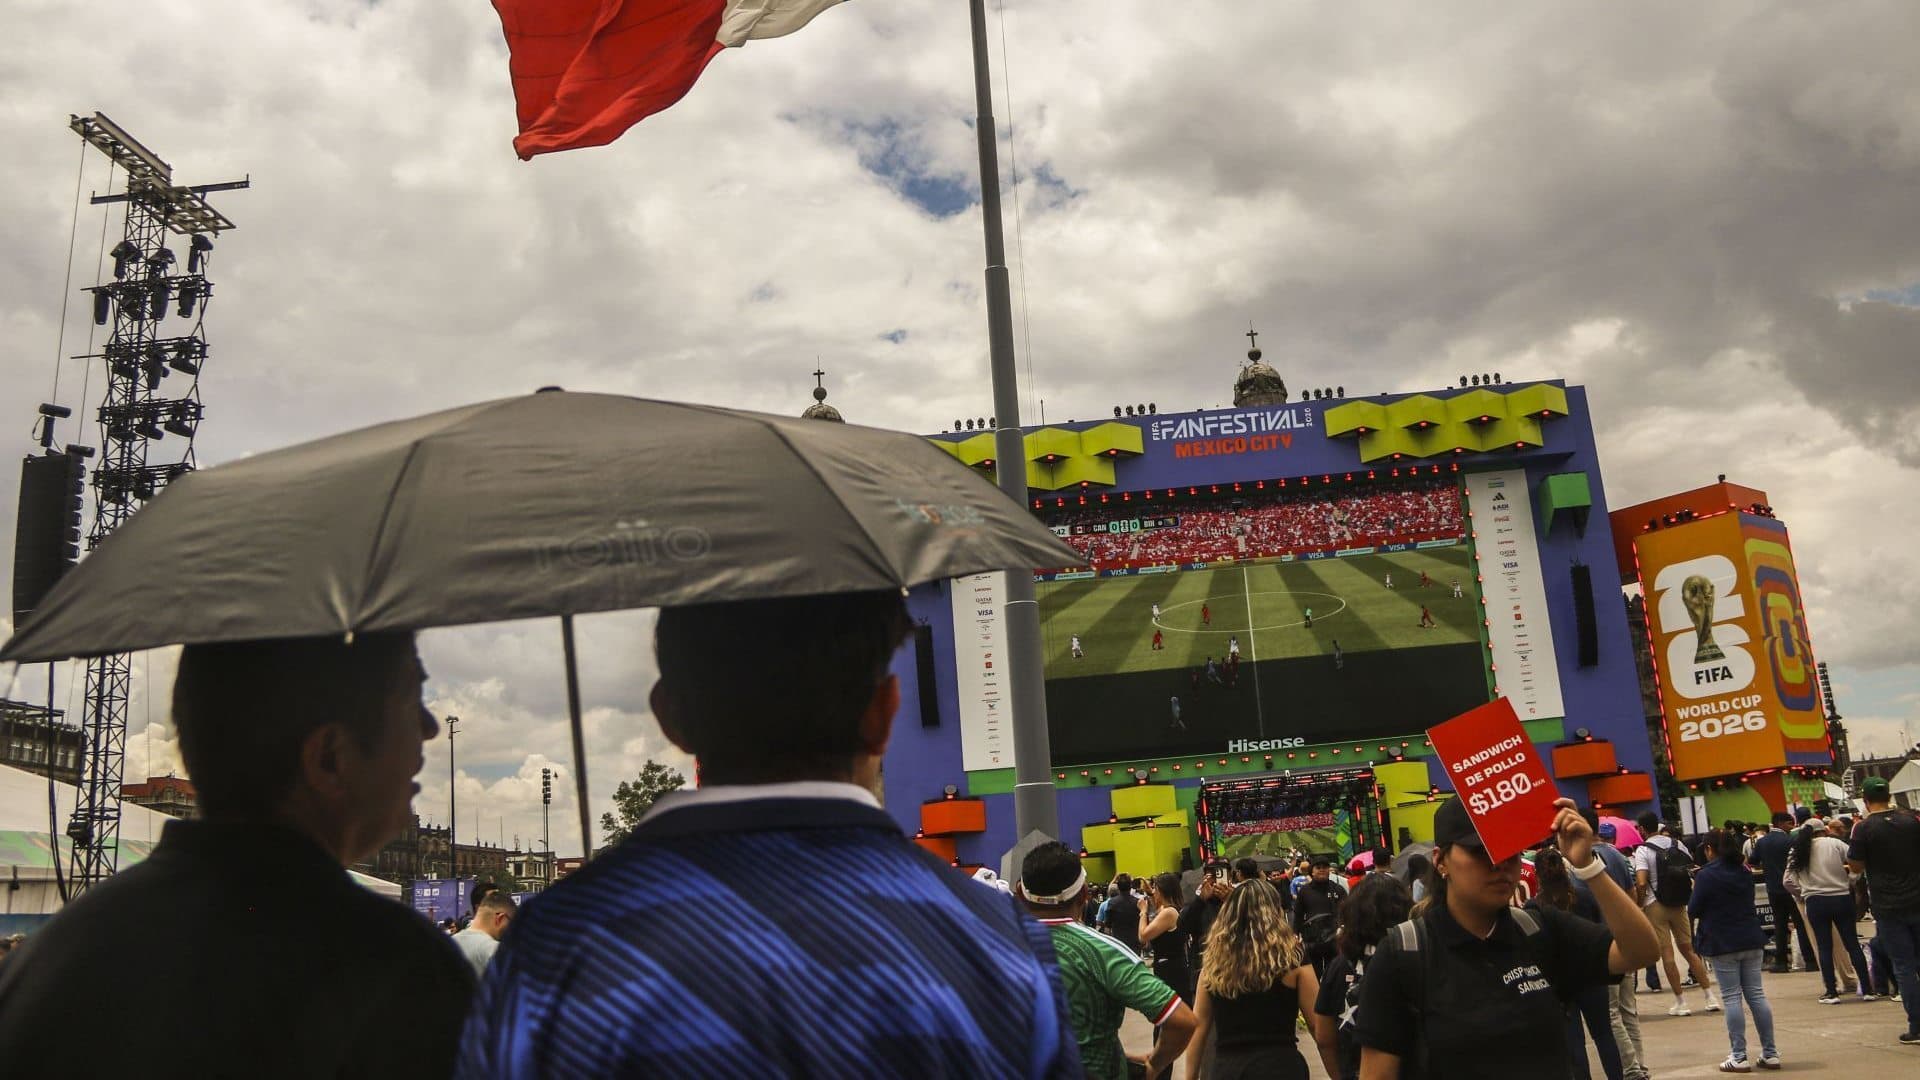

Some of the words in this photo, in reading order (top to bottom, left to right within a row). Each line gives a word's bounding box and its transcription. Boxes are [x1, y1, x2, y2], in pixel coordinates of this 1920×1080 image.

[1152, 421, 1160, 440] FIFA
[1175, 436, 1247, 459] MEXICO
[1250, 432, 1293, 451] CITY
[1093, 524, 1107, 532] CAN
[1503, 561, 1519, 569] VISA
[1694, 665, 1734, 685] FIFA
[1676, 701, 1730, 720] WORLD
[1732, 694, 1762, 709] CUP
[1679, 710, 1767, 742] 2026
[1228, 737, 1305, 753] Hisense
[1452, 734, 1523, 773] SANDWICH
[1464, 771, 1484, 787] DE
[1483, 752, 1526, 778] POLLO
[1468, 772, 1532, 815] $180
[1503, 966, 1523, 984] CRISP
